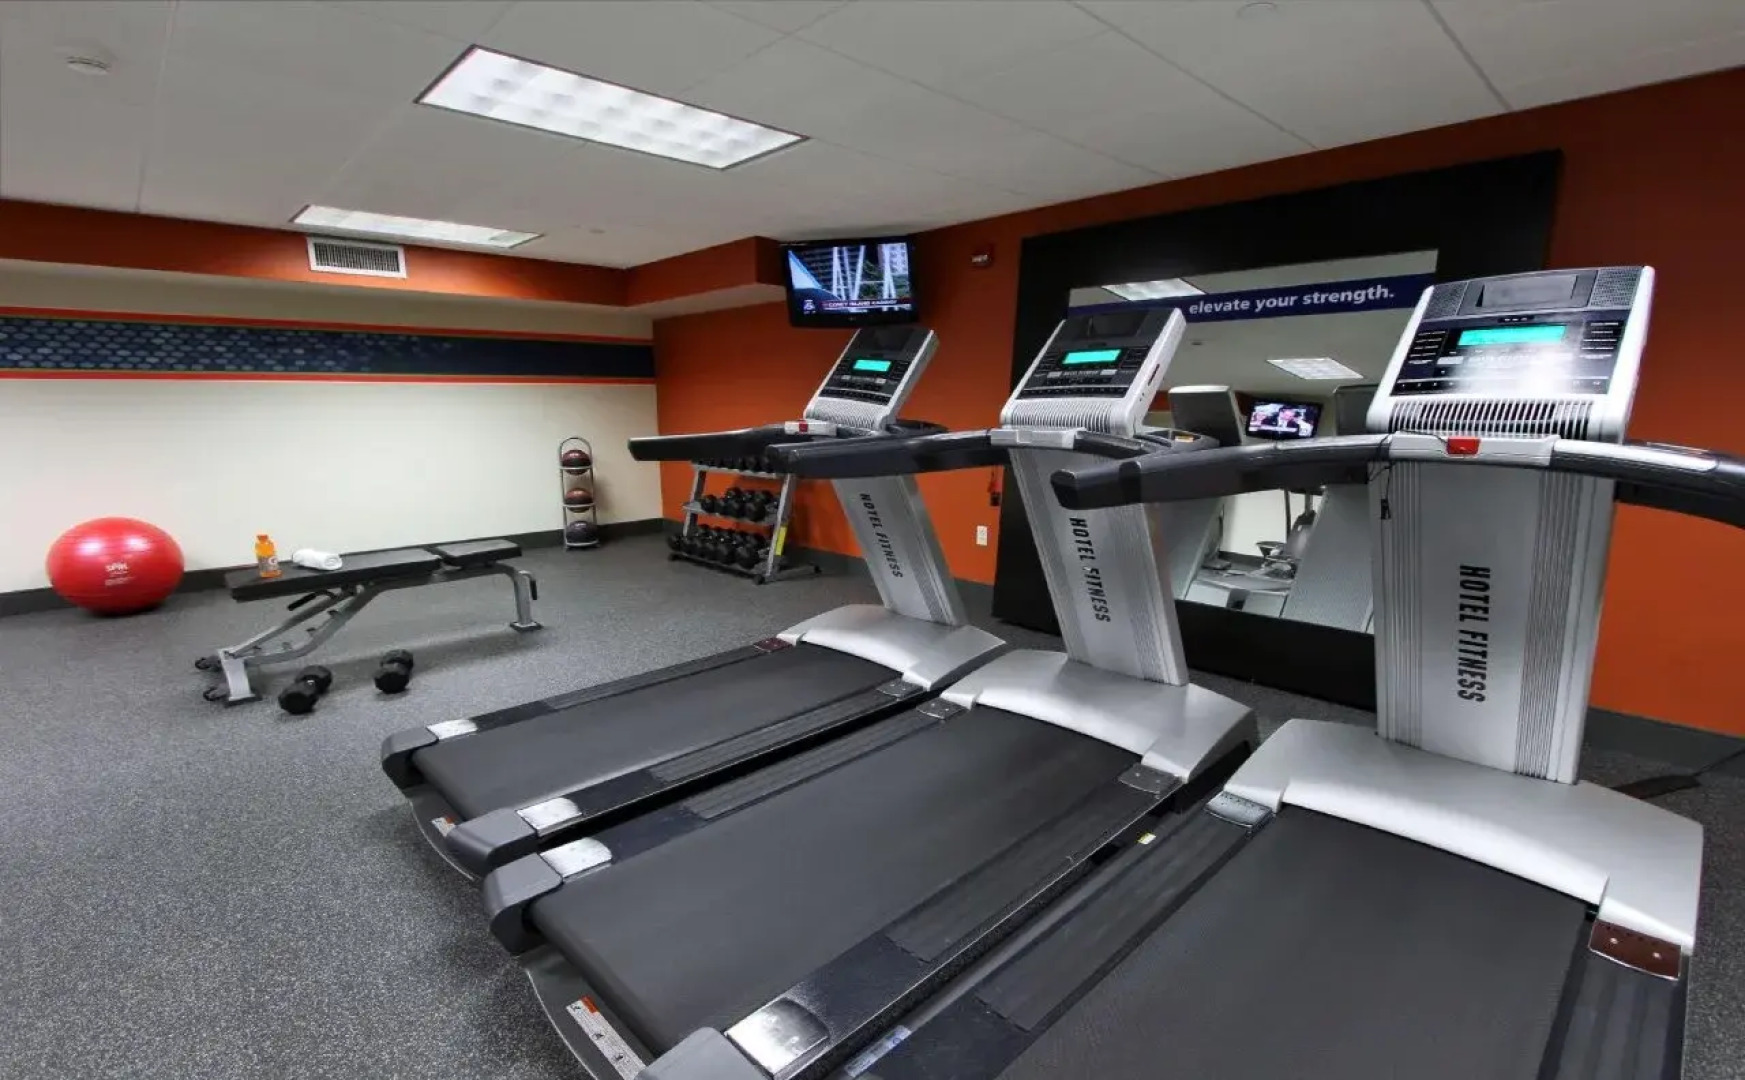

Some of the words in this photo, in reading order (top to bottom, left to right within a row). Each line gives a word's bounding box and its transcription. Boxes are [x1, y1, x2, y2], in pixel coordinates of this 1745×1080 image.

[1189, 300, 1250, 315] elevate
[1255, 294, 1298, 312] your
[1302, 284, 1395, 304] strength.
[860, 493, 883, 529] HOTEL
[875, 532, 903, 578] FITNESS
[1069, 517, 1096, 561] HOTEL
[1459, 565, 1490, 622] HOTEL
[1457, 629, 1488, 702] FITNESS
